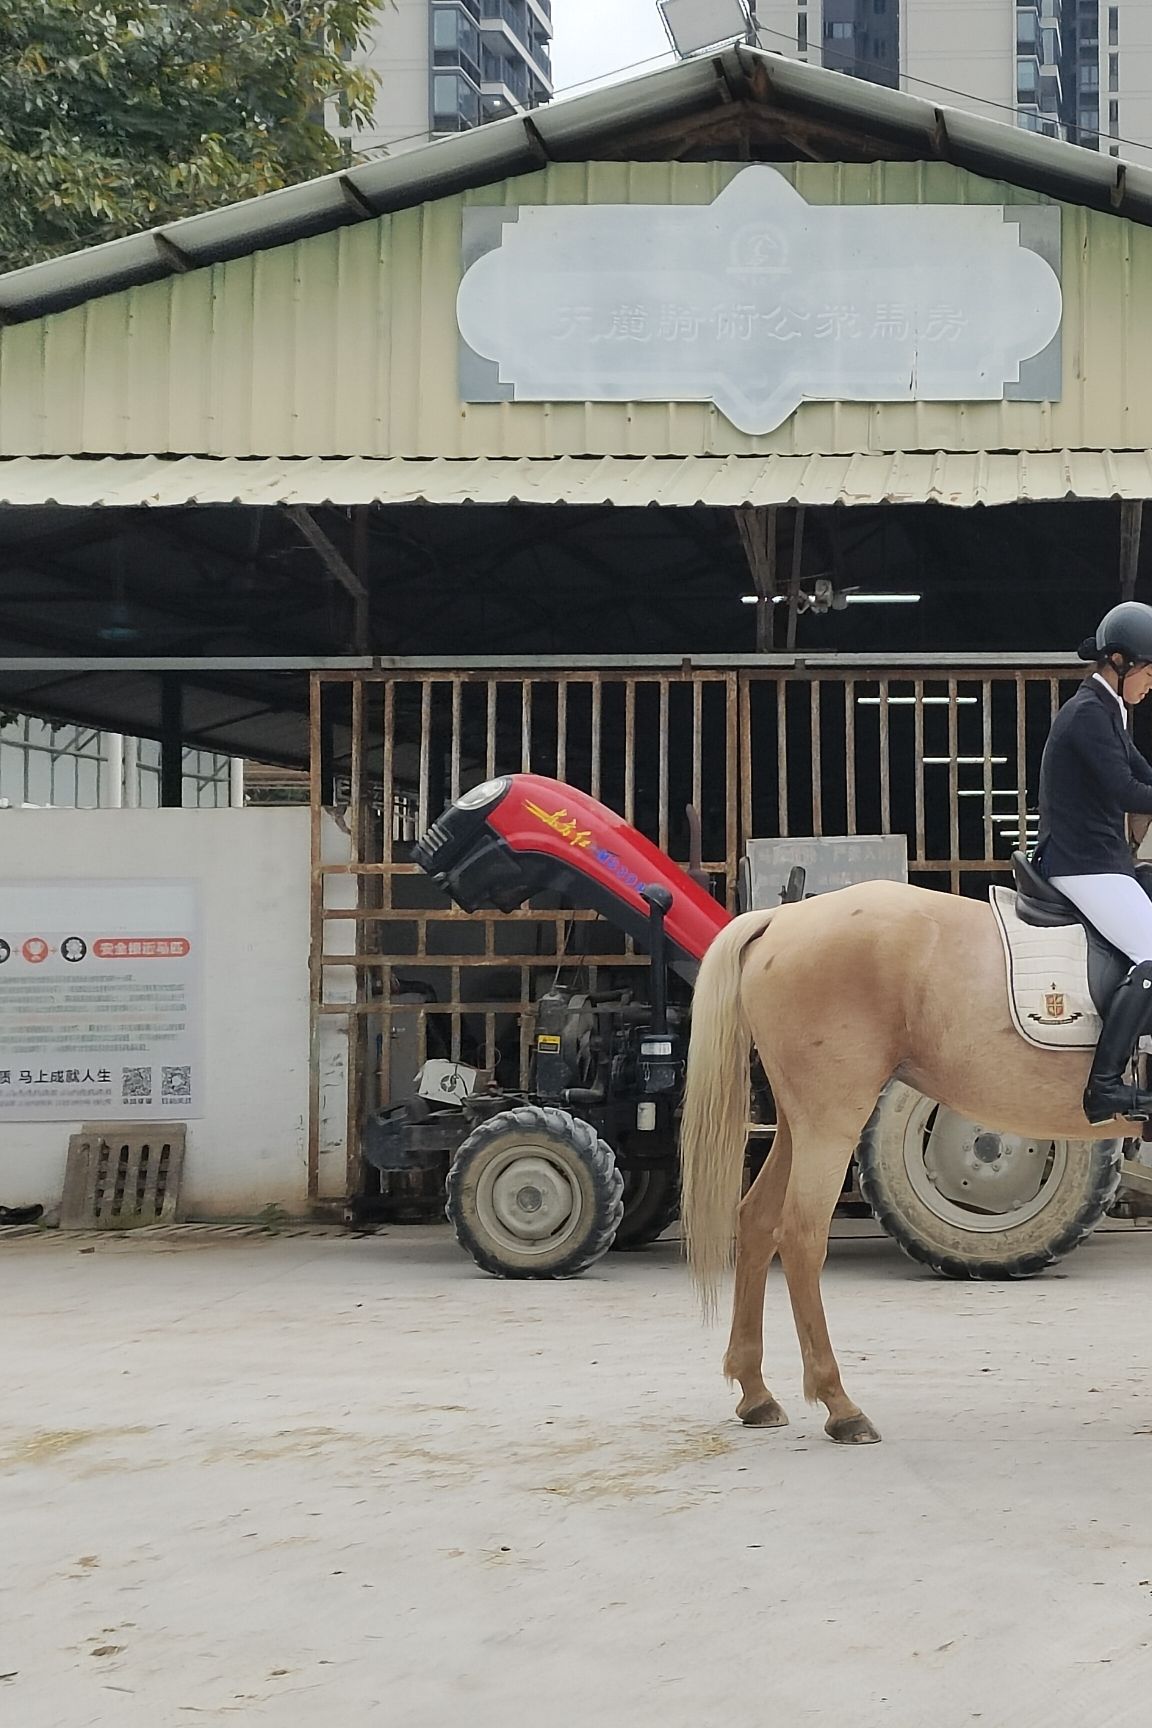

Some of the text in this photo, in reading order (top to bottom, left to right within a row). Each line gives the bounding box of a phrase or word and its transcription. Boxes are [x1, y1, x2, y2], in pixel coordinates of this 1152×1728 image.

[18, 1068, 113, 1084] 马上成就人生
